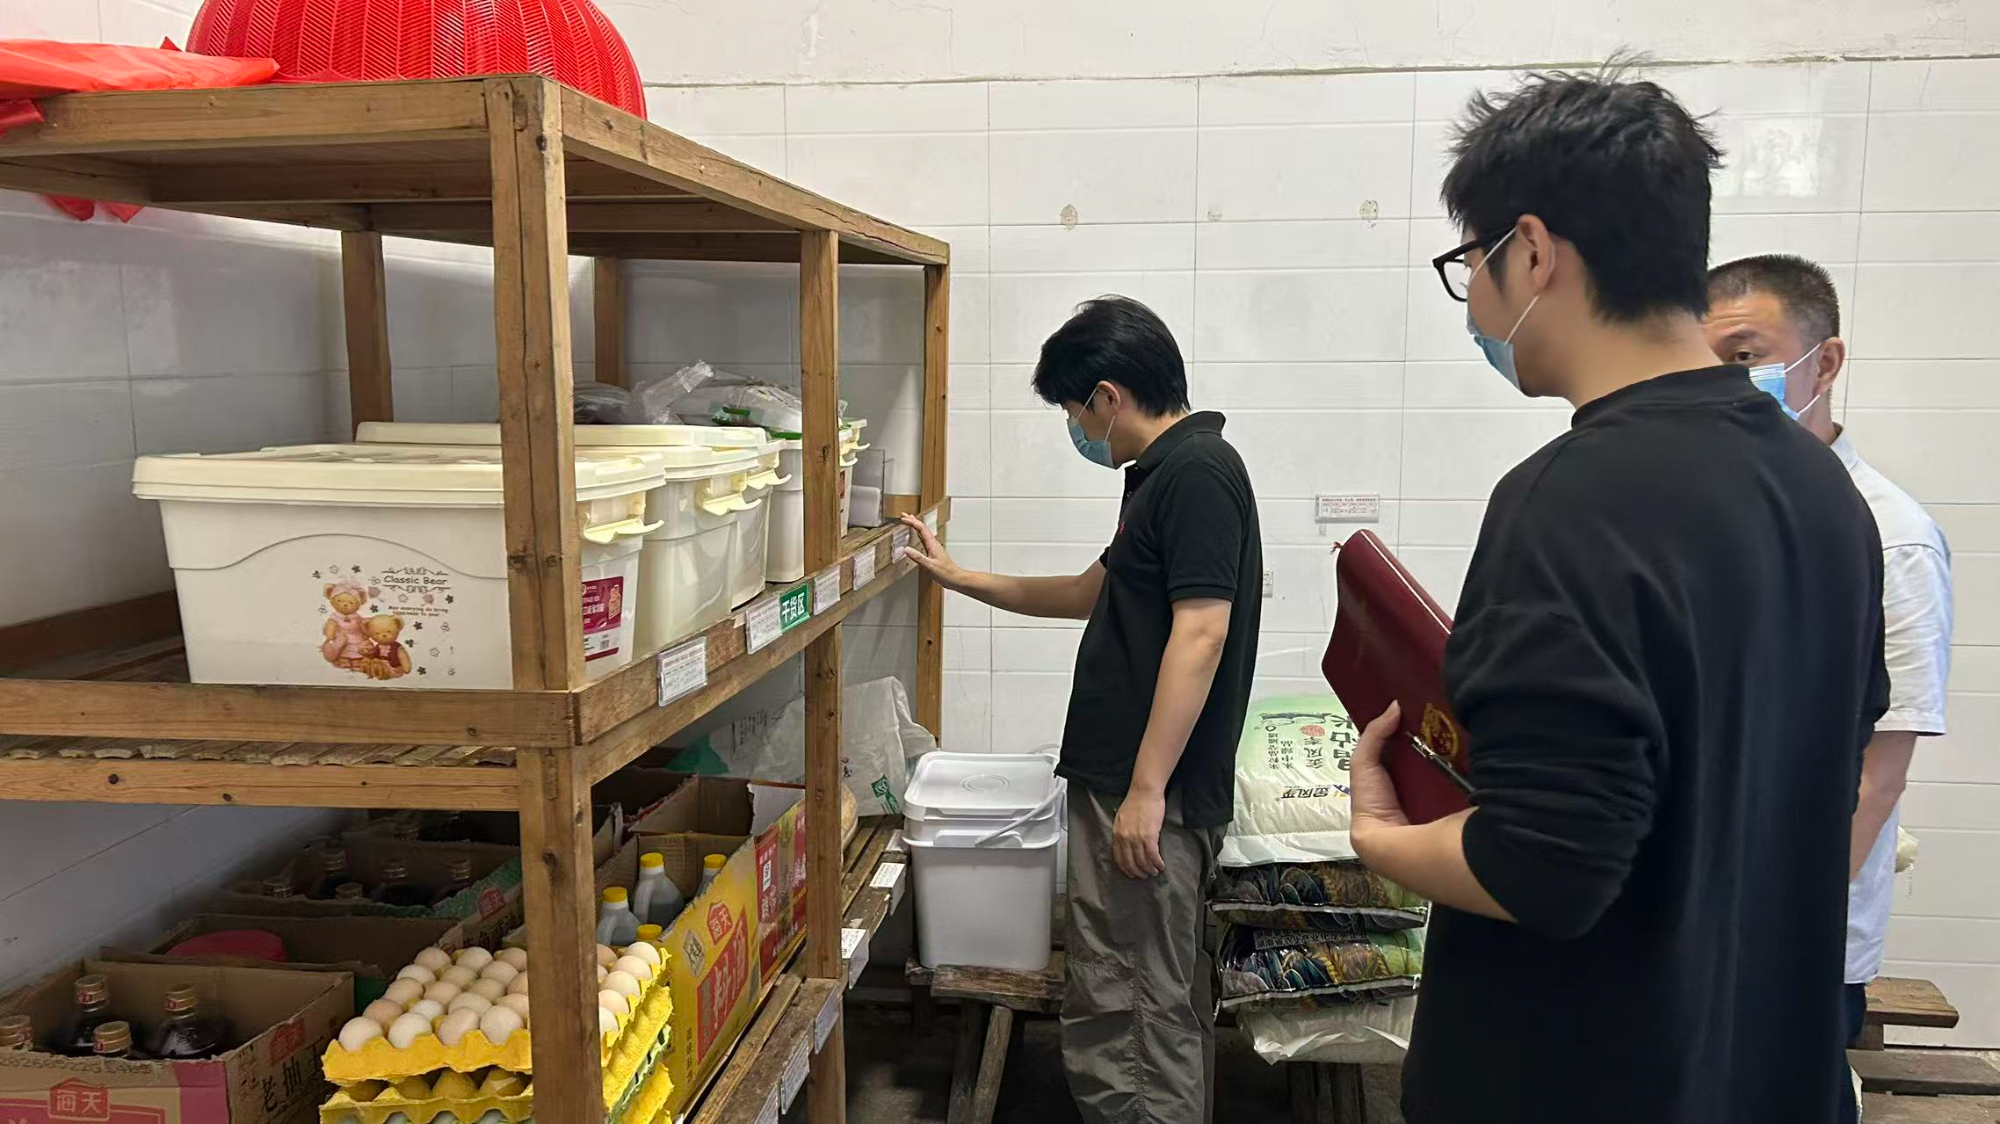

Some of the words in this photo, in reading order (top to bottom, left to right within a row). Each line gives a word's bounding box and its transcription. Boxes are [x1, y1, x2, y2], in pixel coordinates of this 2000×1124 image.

[384, 575, 419, 584] Classic
[423, 576, 447, 585] Bear
[782, 592, 805, 623] 干货区
[709, 908, 732, 937] 海天
[57, 1090, 102, 1113] 海天
